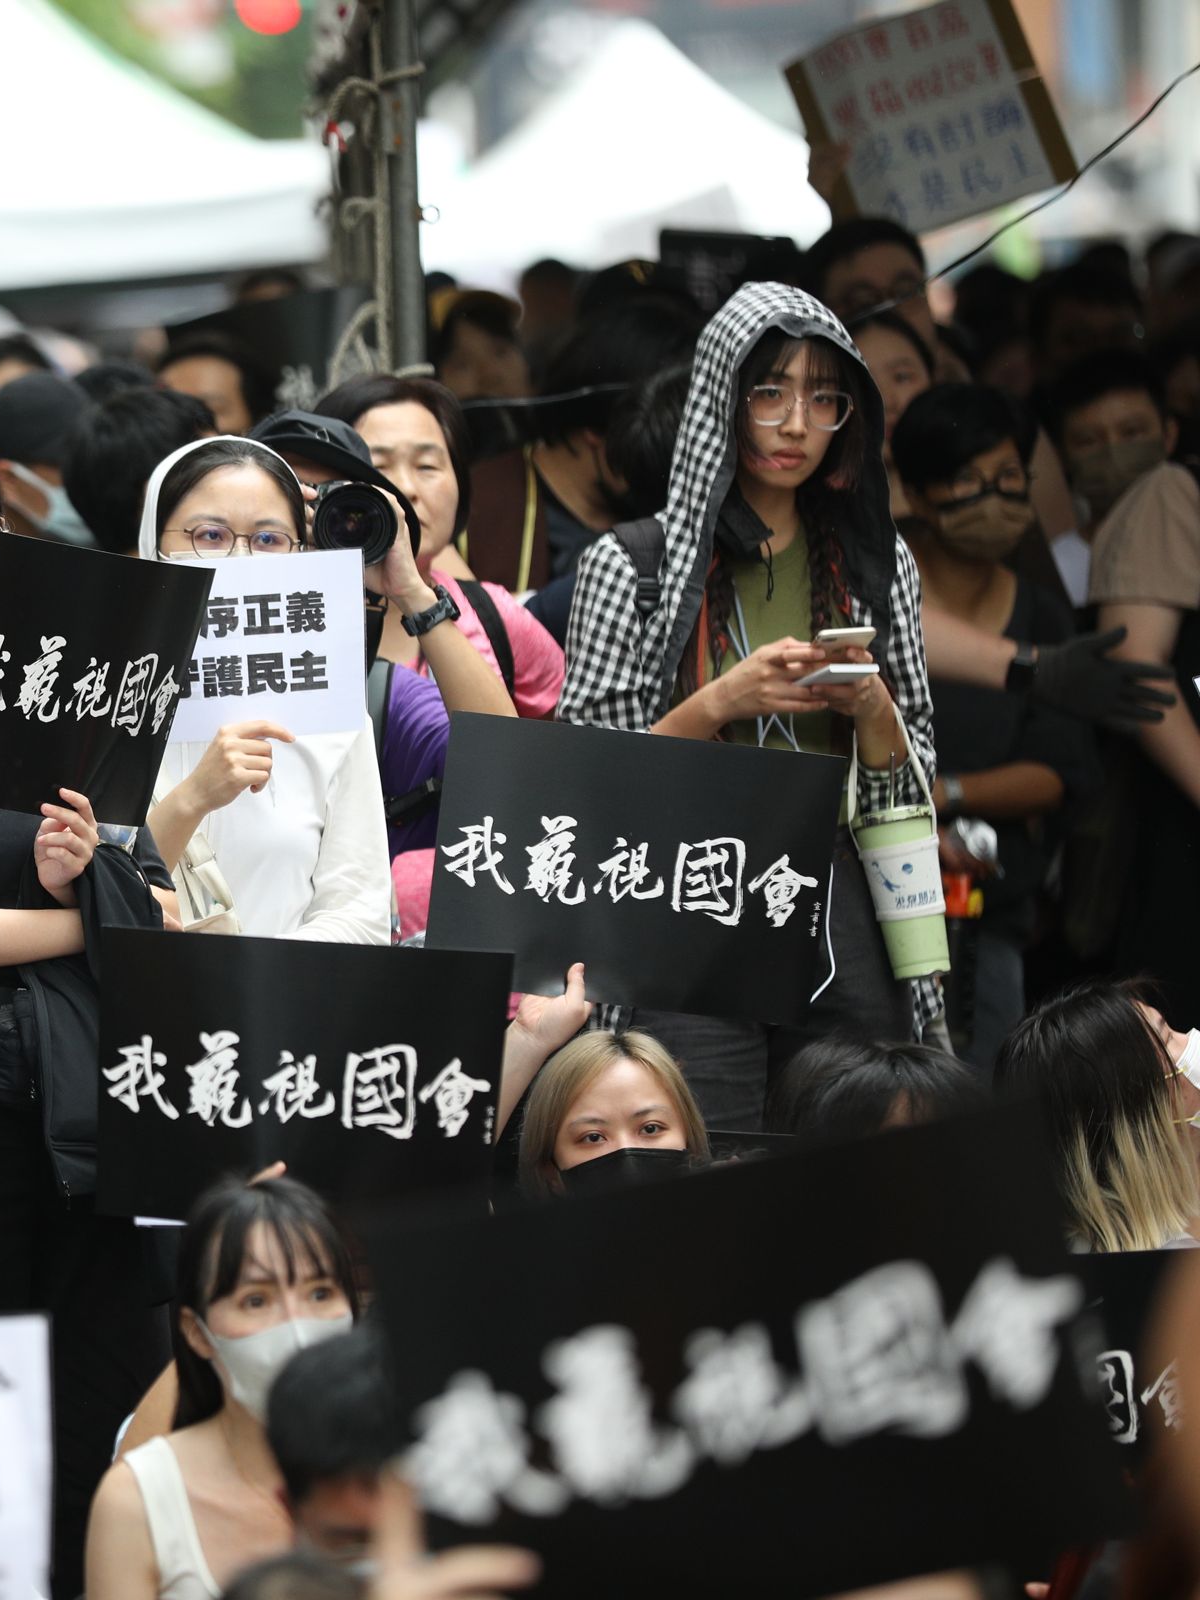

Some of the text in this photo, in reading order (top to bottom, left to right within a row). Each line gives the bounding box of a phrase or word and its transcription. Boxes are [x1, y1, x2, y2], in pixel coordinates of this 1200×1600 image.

[441, 815, 819, 927] 我藐視國會
[102, 1030, 491, 1140] 我藐視國會
